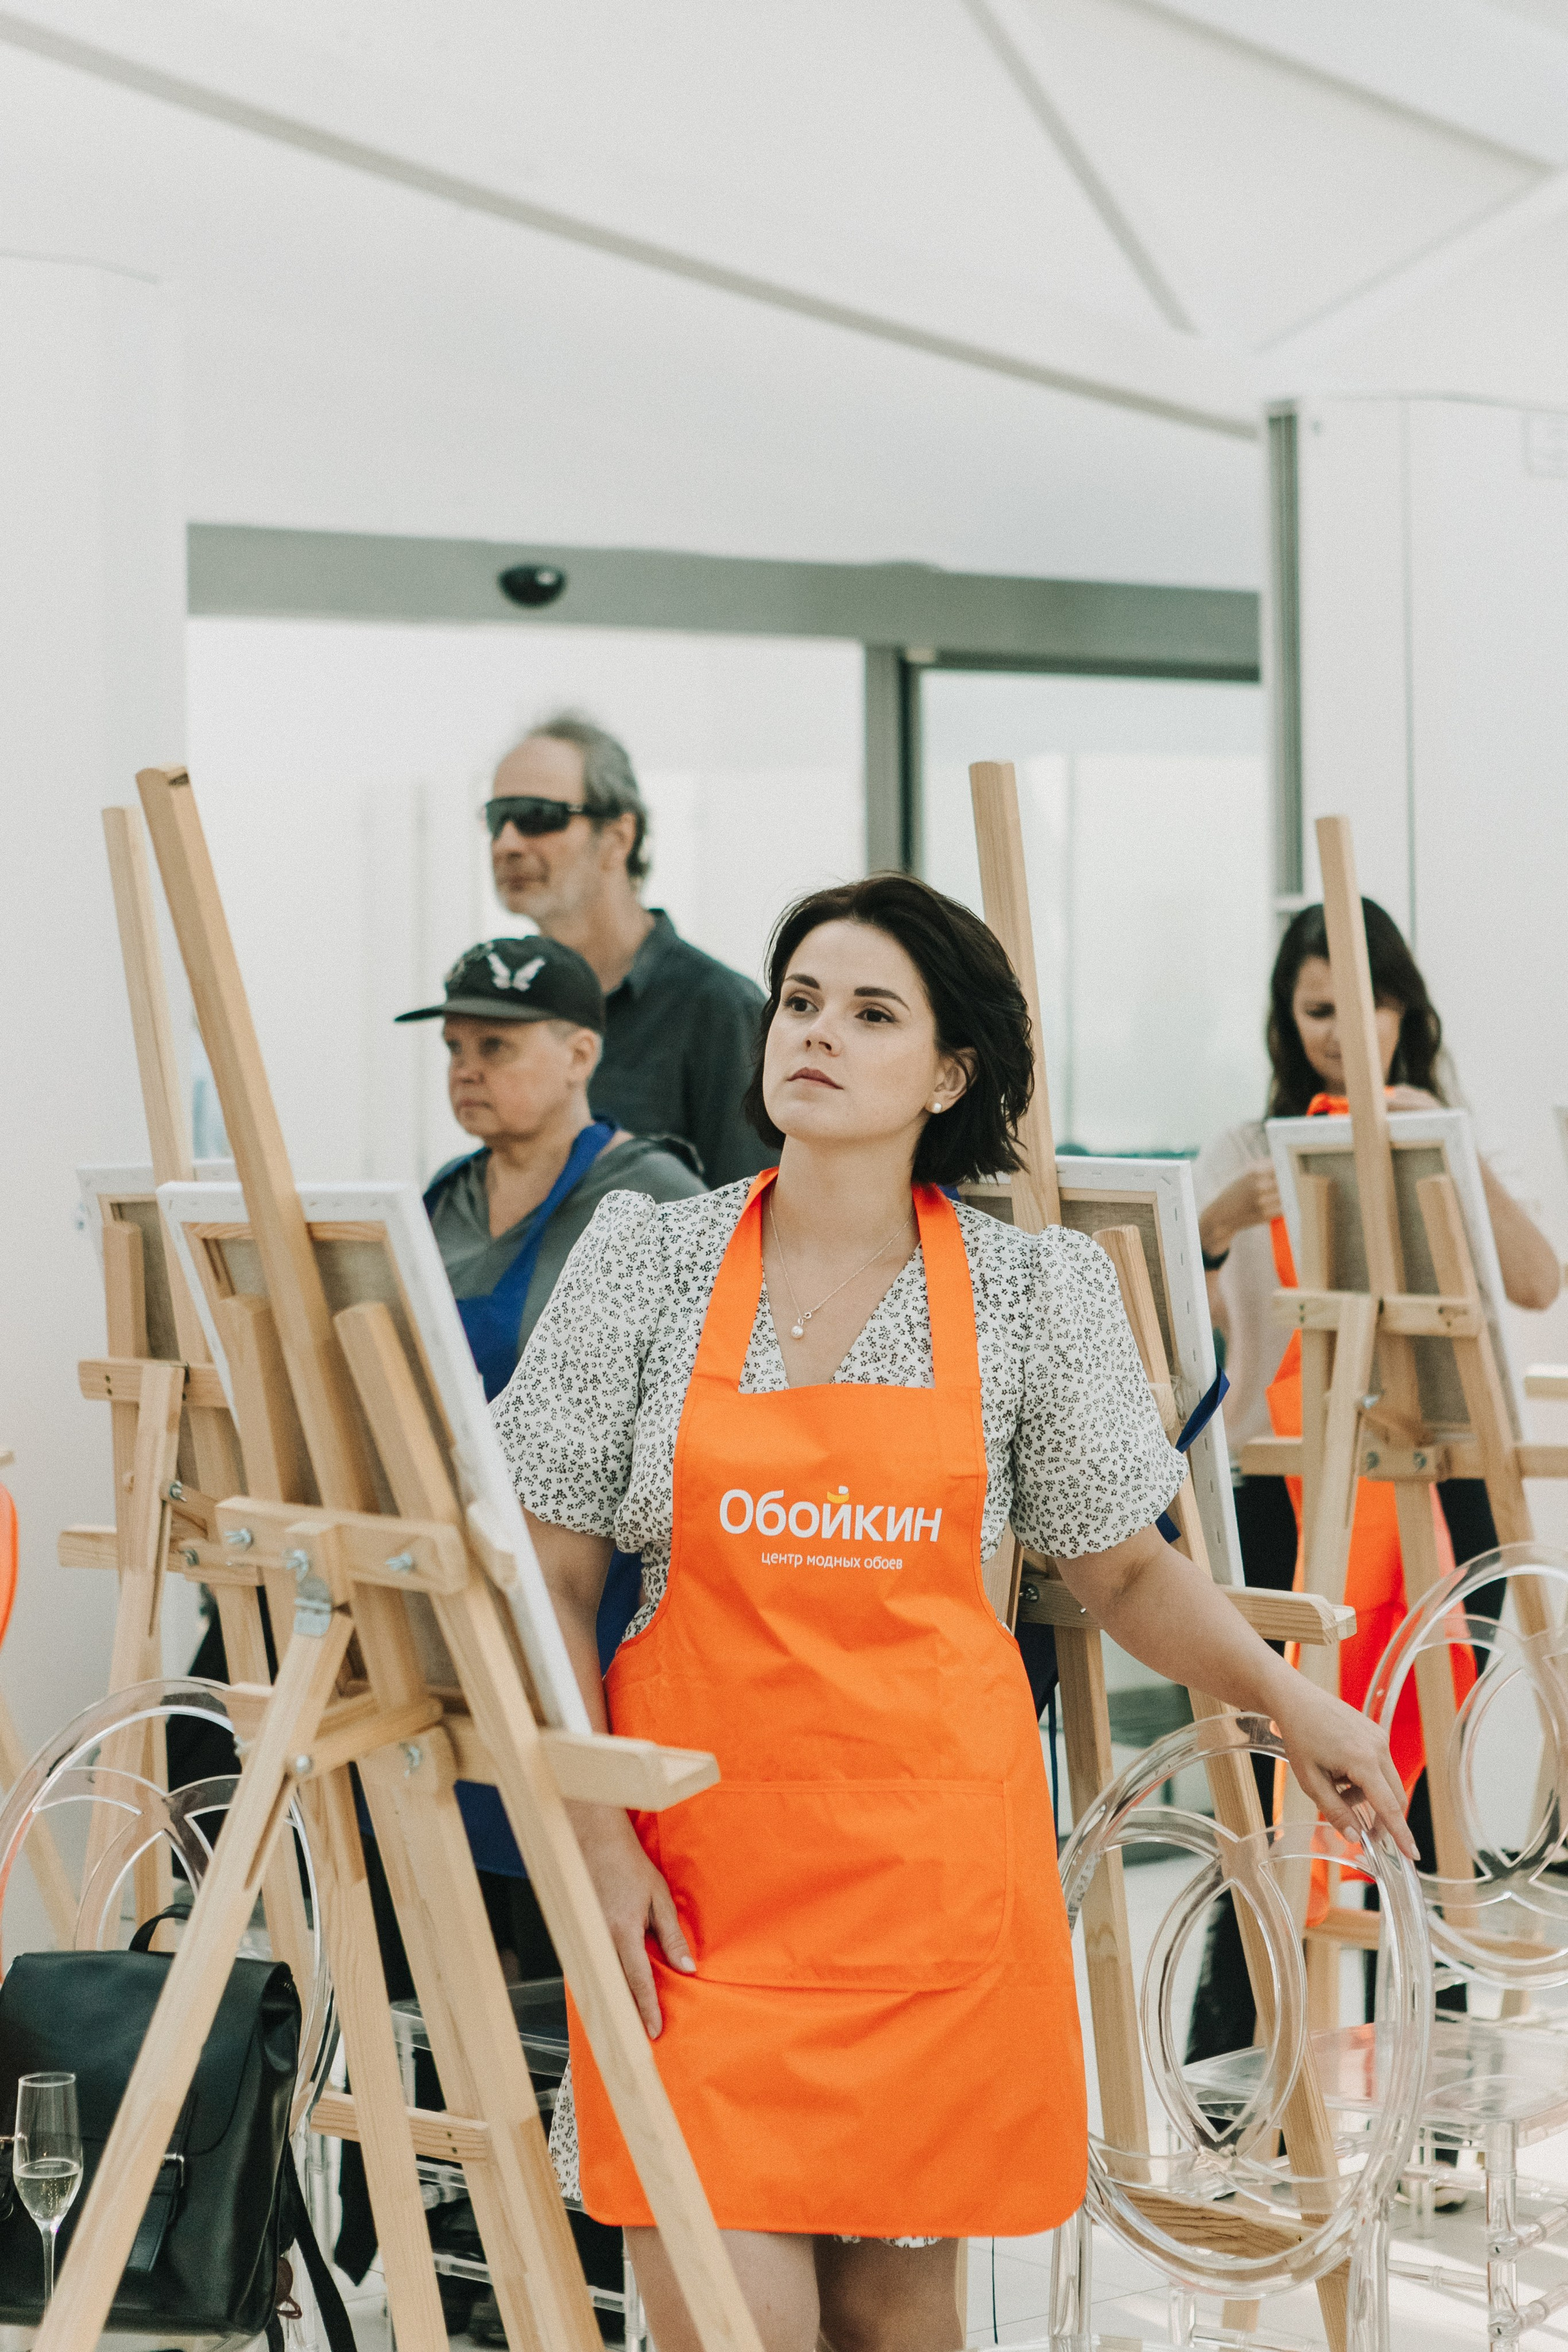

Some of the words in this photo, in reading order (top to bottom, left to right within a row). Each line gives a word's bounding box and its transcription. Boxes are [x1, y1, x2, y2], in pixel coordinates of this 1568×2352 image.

[719, 1485, 943, 1542] Обойкин
[761, 1552, 803, 1568] центр
[807, 1555, 861, 1569] модных
[864, 1556, 903, 1570] обоев
